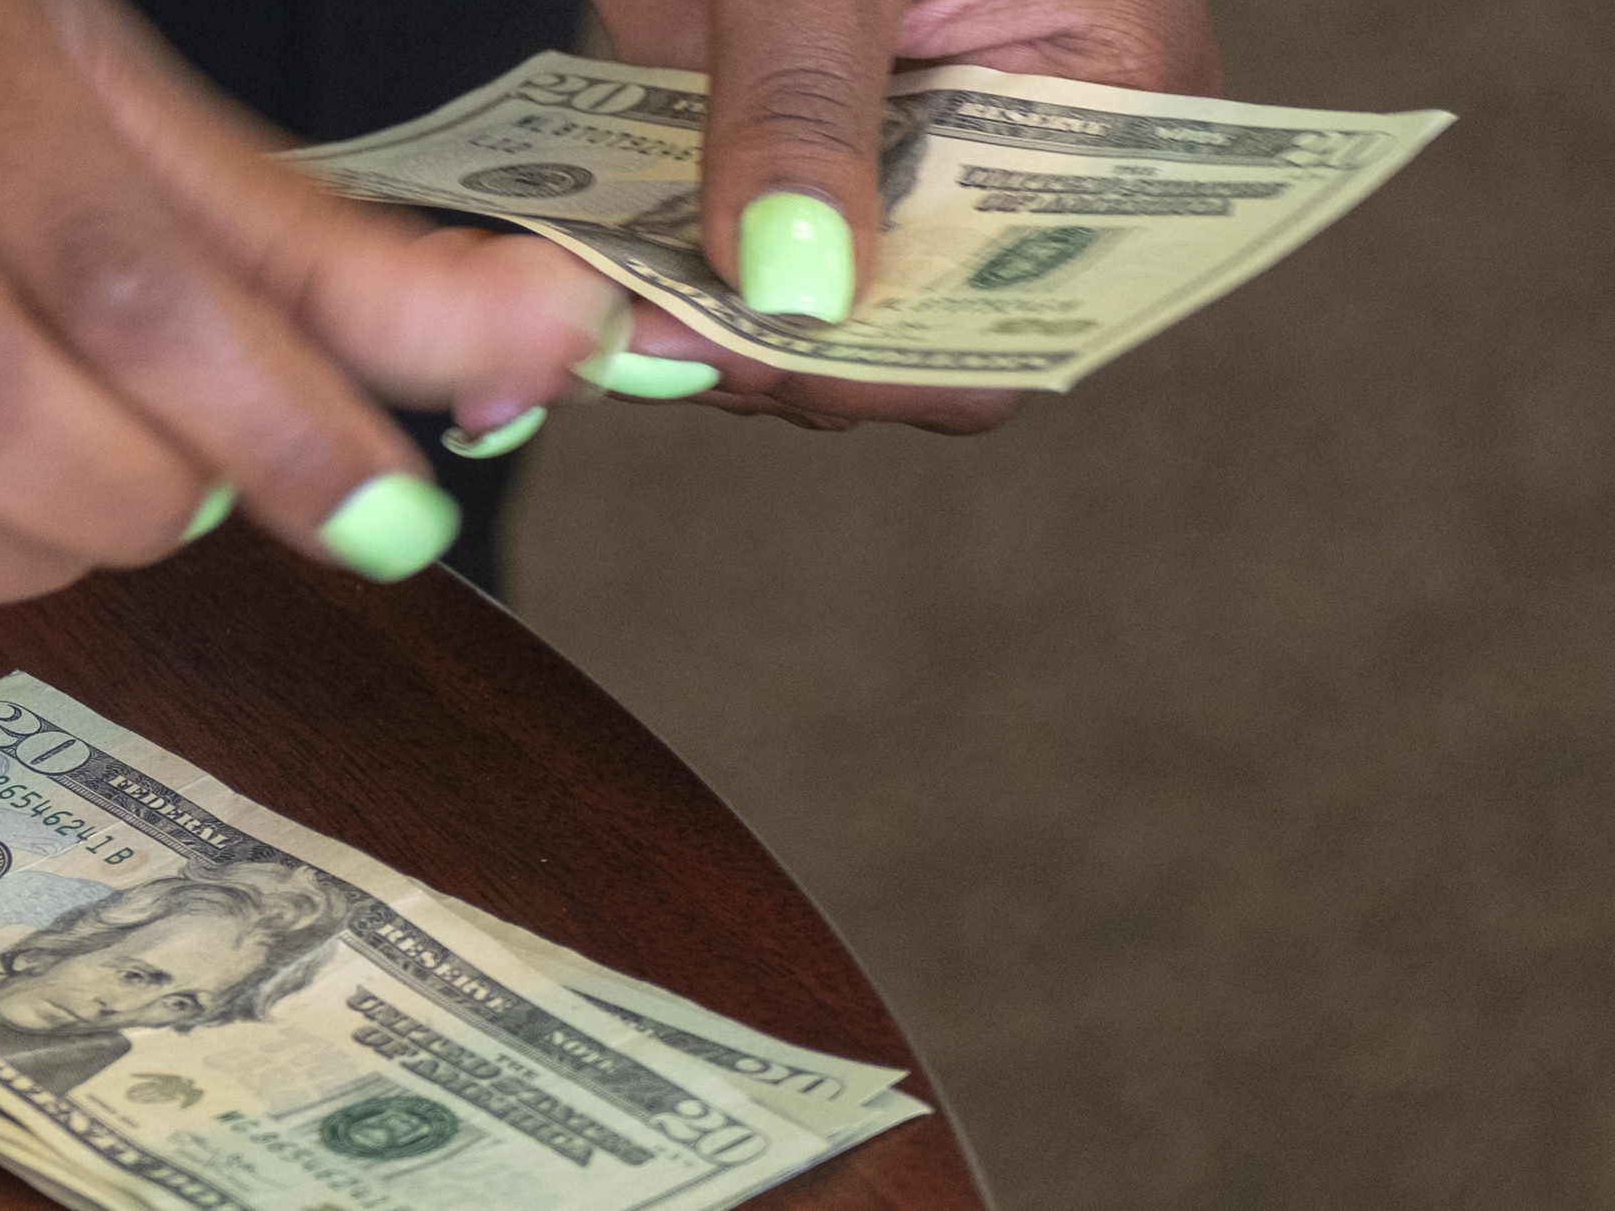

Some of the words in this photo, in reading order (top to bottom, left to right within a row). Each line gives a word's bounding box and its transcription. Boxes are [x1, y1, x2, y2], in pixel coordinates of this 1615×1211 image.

[107, 773, 230, 851] FEDERAL
[346, 984, 502, 1082] UNITED
[377, 923, 517, 1014] RESERVE
[649, 1098, 771, 1166] 20
